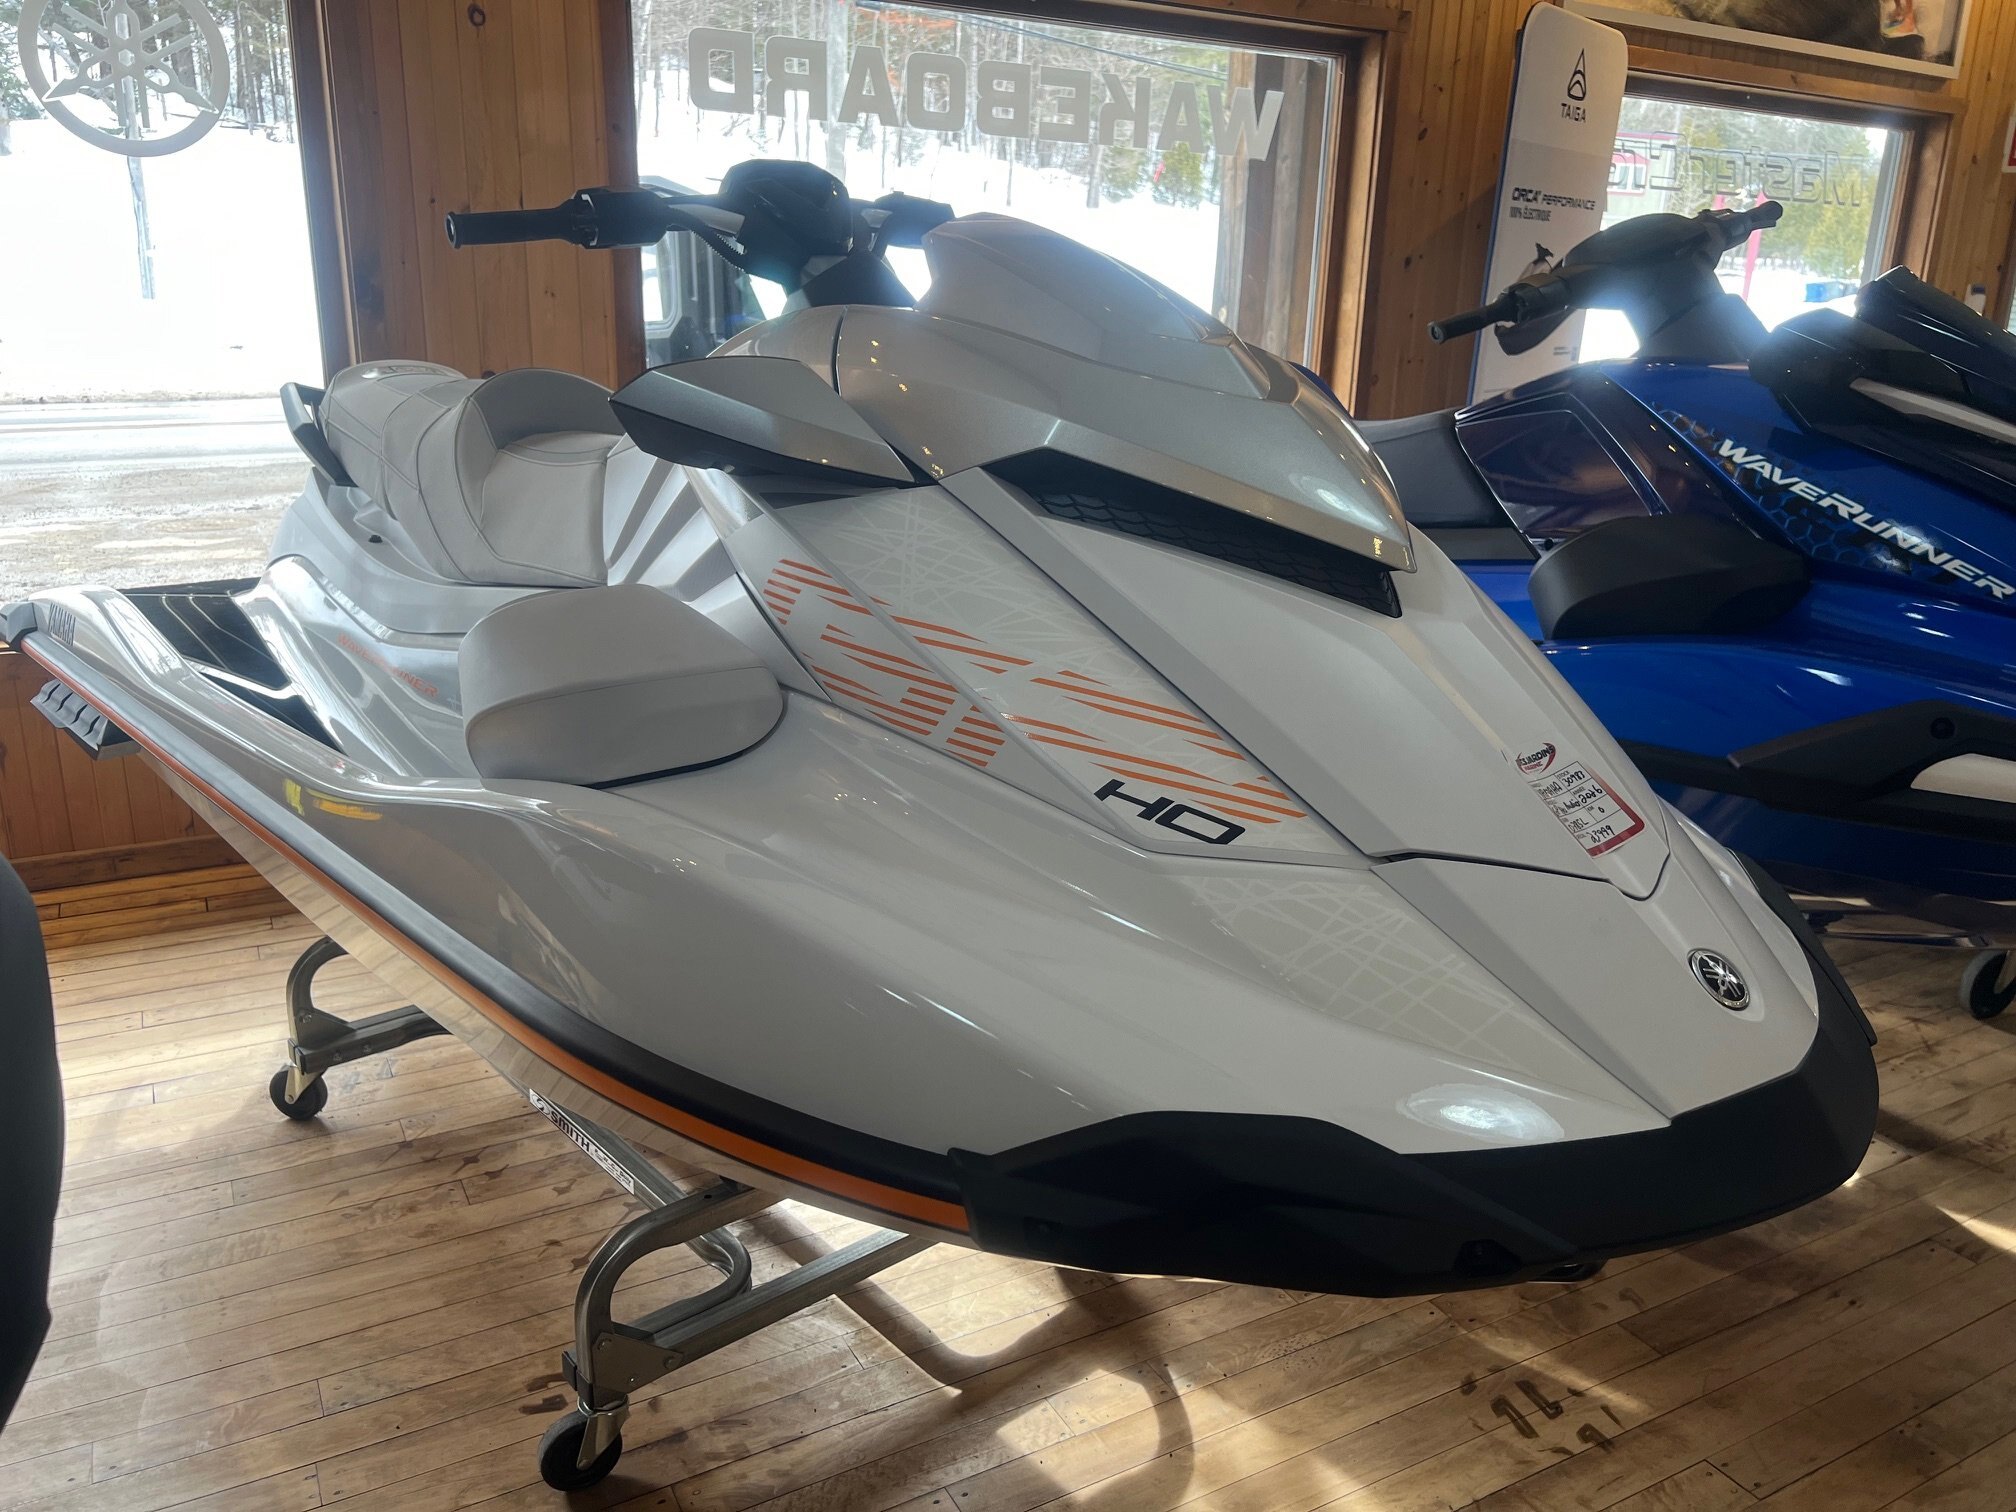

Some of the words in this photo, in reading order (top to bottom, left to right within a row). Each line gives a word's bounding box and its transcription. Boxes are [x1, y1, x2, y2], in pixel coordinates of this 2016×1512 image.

[1561, 102, 1586, 123] TAIGA
[1512, 187, 1540, 204] ORCA
[1542, 193, 1596, 211] PERFORMANCE
[1094, 778, 1246, 845] HO
[550, 1110, 590, 1153] SMITH
